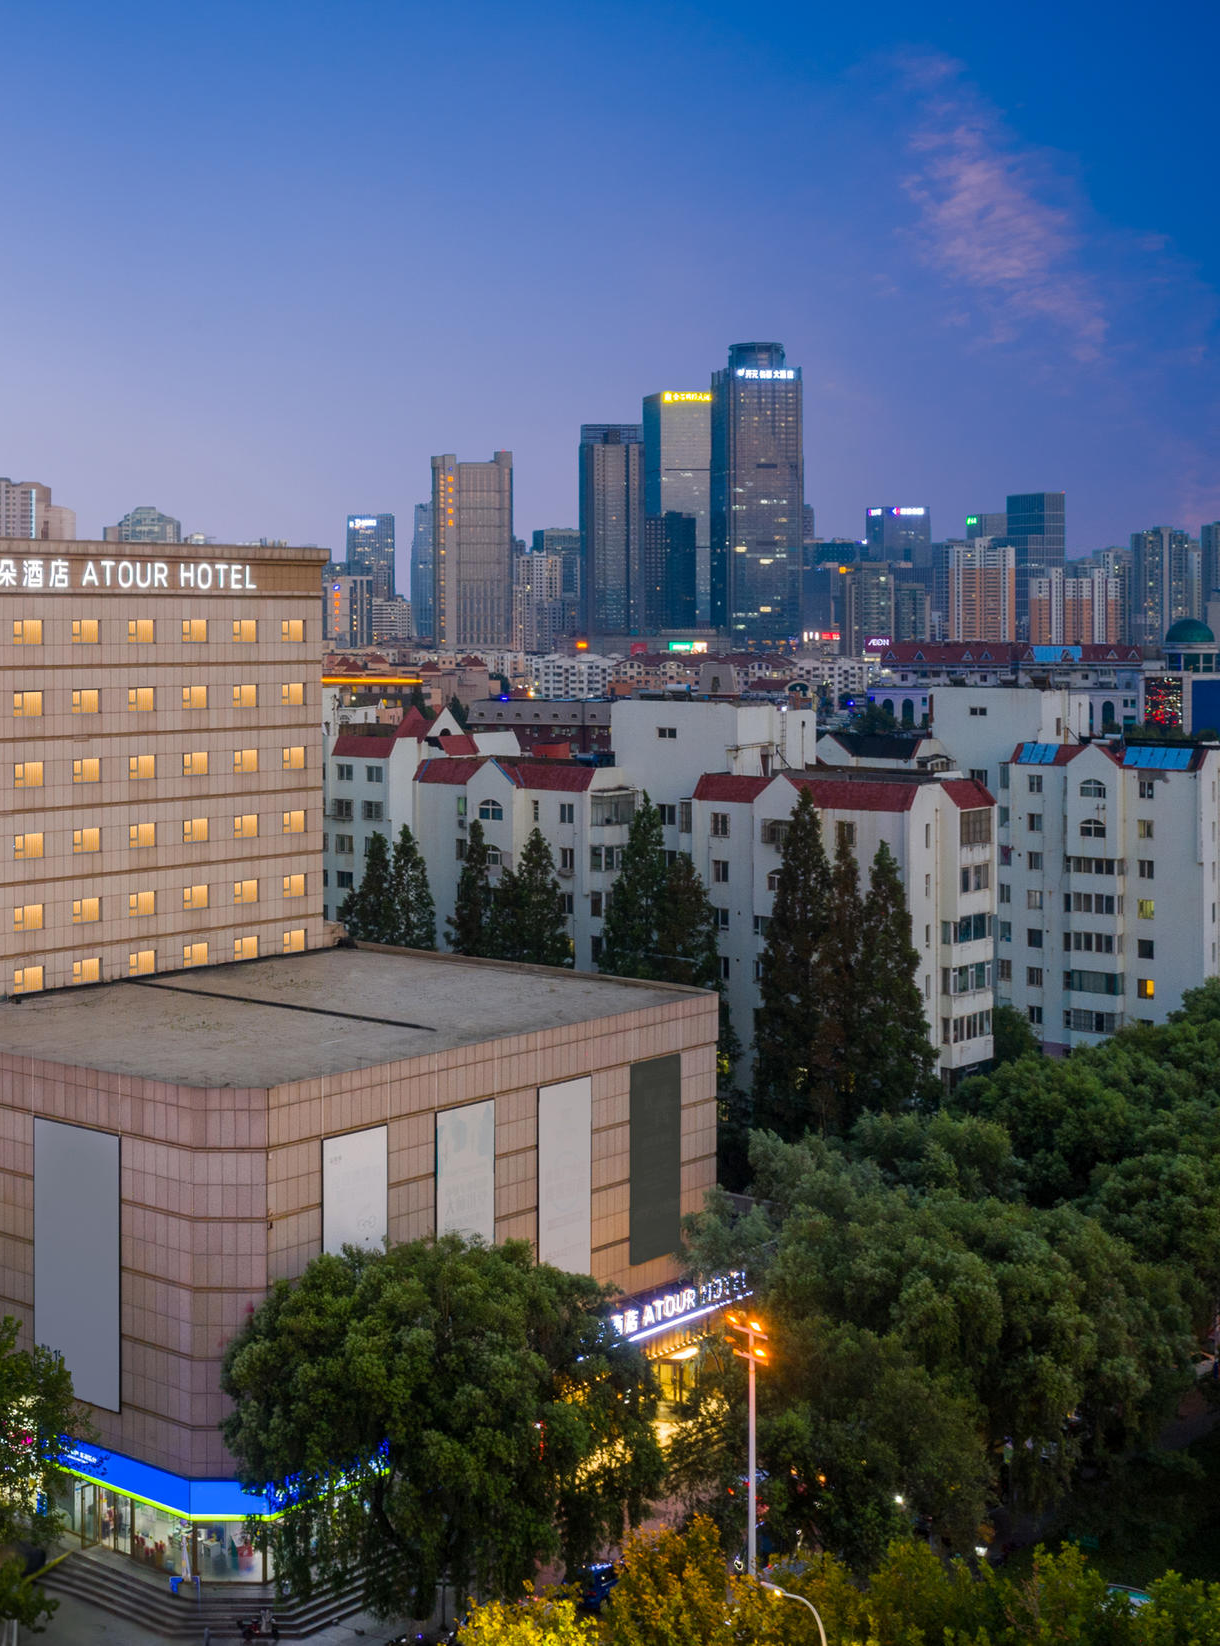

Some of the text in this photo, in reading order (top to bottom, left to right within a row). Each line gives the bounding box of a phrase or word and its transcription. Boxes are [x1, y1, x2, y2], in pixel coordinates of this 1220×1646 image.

[82, 560, 168, 588] ATOUR
[180, 563, 257, 590] HOTEL
[642, 1287, 697, 1327] ATOUR
